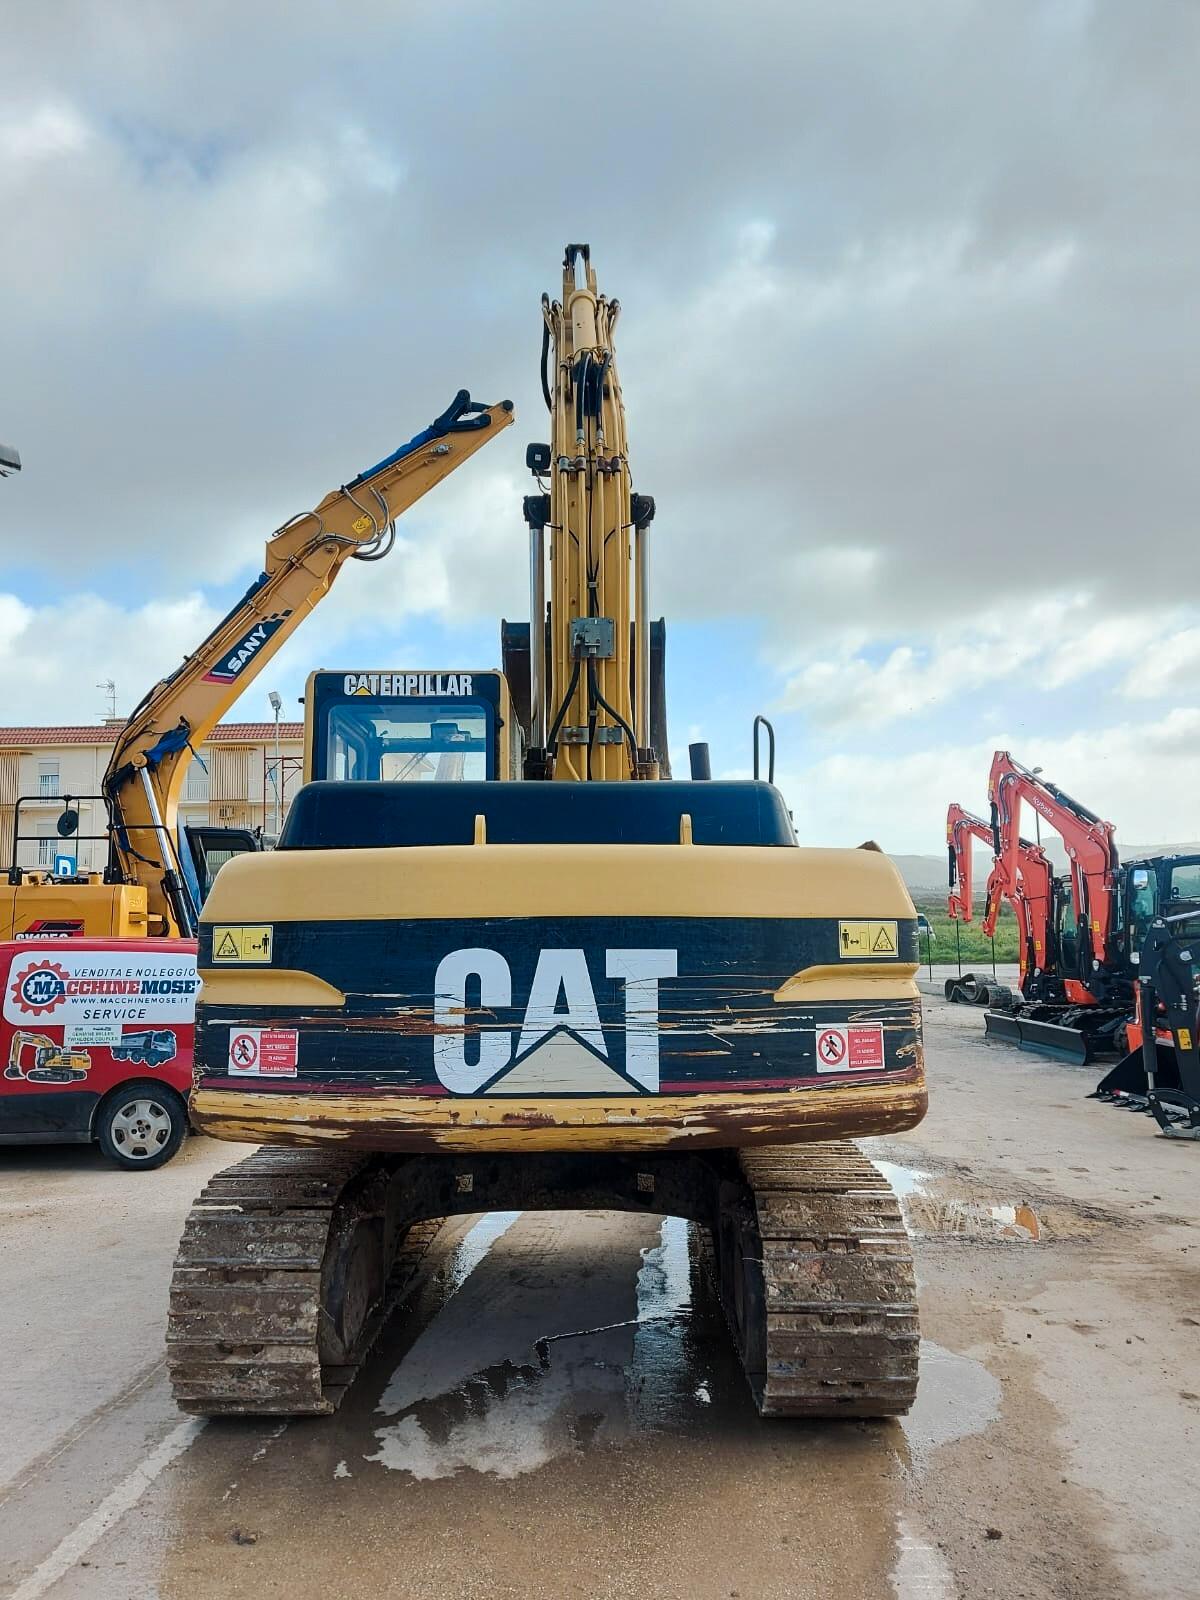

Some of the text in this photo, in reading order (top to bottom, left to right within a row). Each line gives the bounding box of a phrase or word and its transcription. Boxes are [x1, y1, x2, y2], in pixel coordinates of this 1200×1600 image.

[227, 624, 267, 673] SANY
[343, 674, 473, 696] CATERPILLAR
[74, 968, 196, 977] VENDITA E NOLEGGIO
[82, 1008, 147, 1019] SERVICE
[433, 947, 678, 1094] CAT
